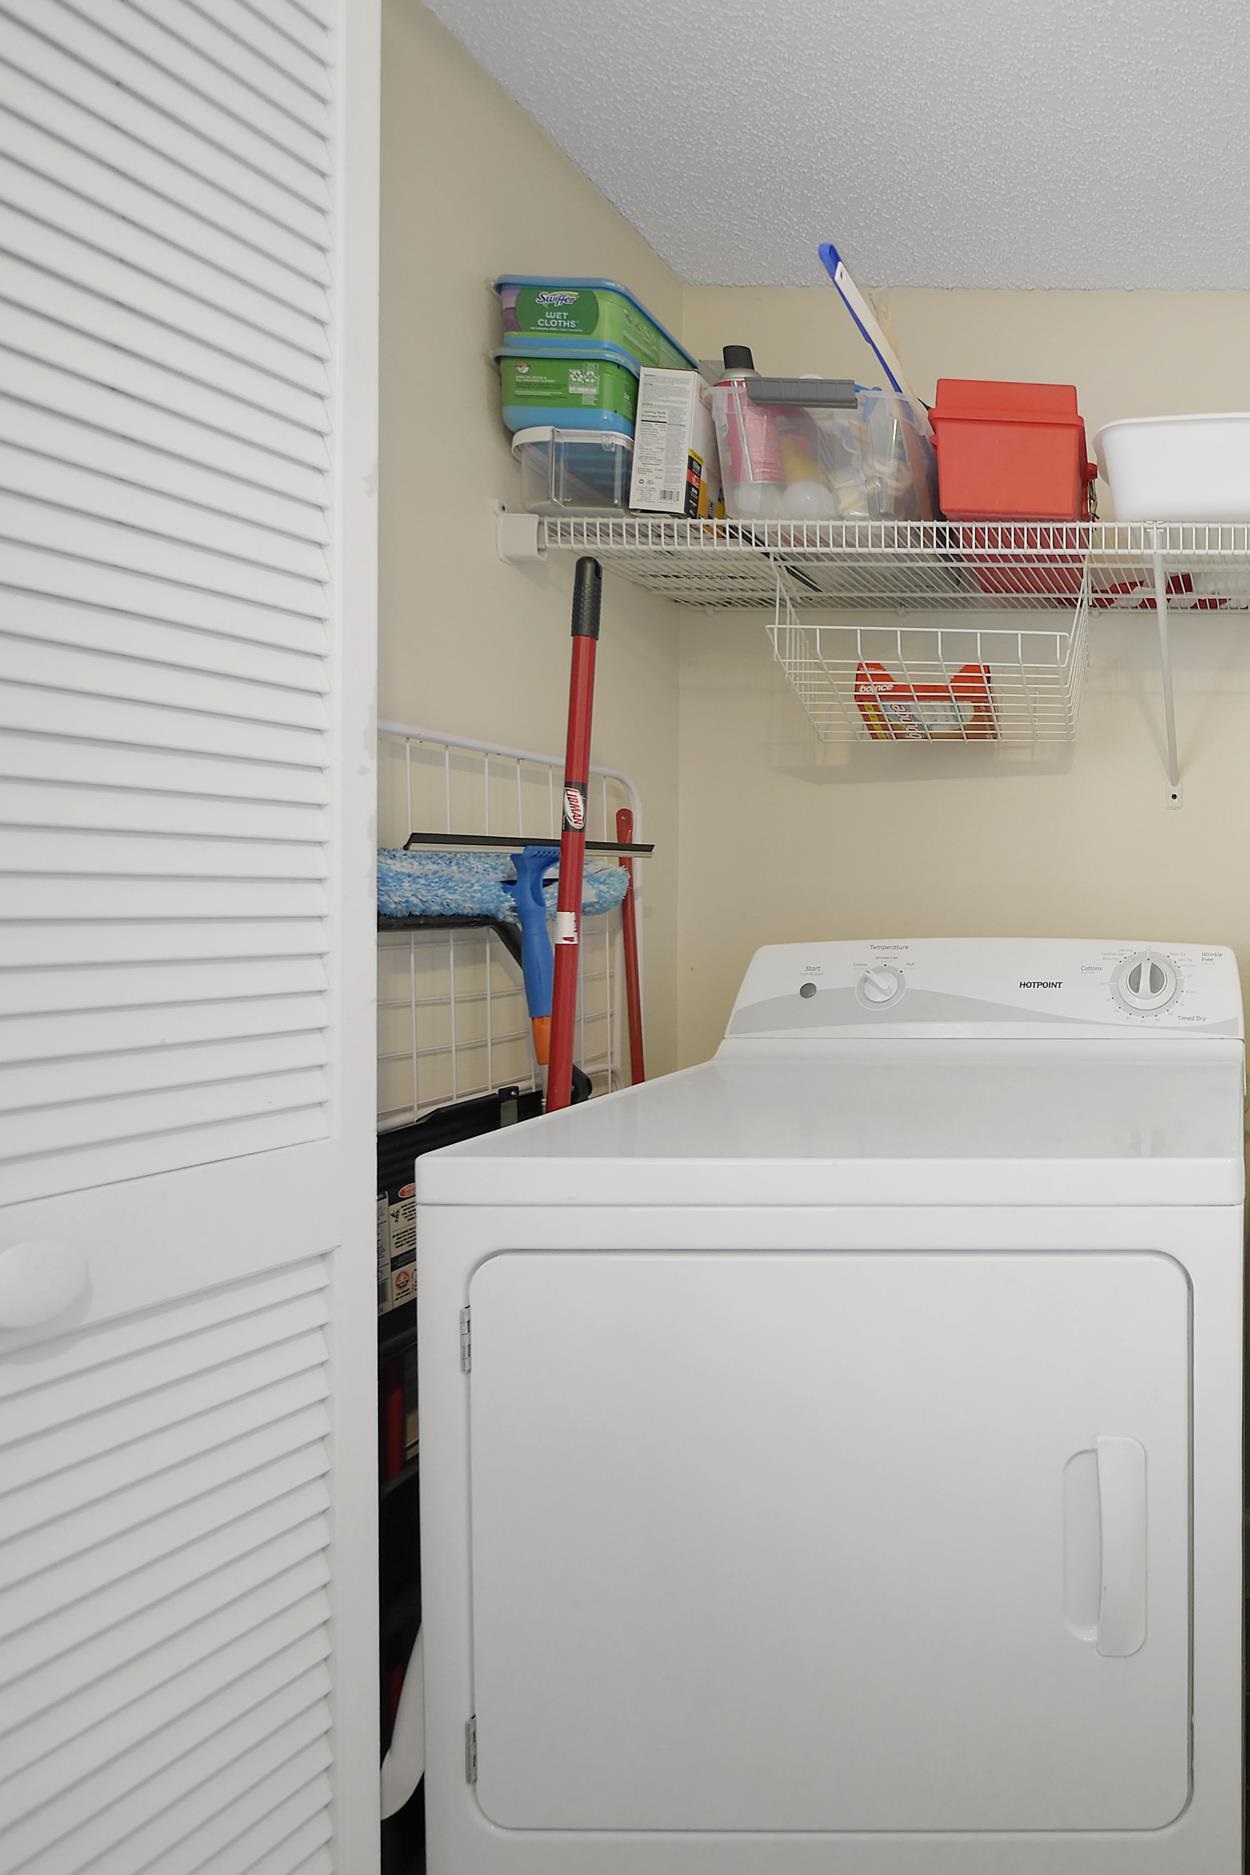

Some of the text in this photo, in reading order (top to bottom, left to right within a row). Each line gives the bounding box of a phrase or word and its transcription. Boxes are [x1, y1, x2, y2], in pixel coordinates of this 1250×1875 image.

[535, 291, 577, 307] Swiffer
[545, 311, 569, 320] WET
[537, 319, 577, 328] CLOTHS
[1019, 981, 1064, 989] HOTPOINT
